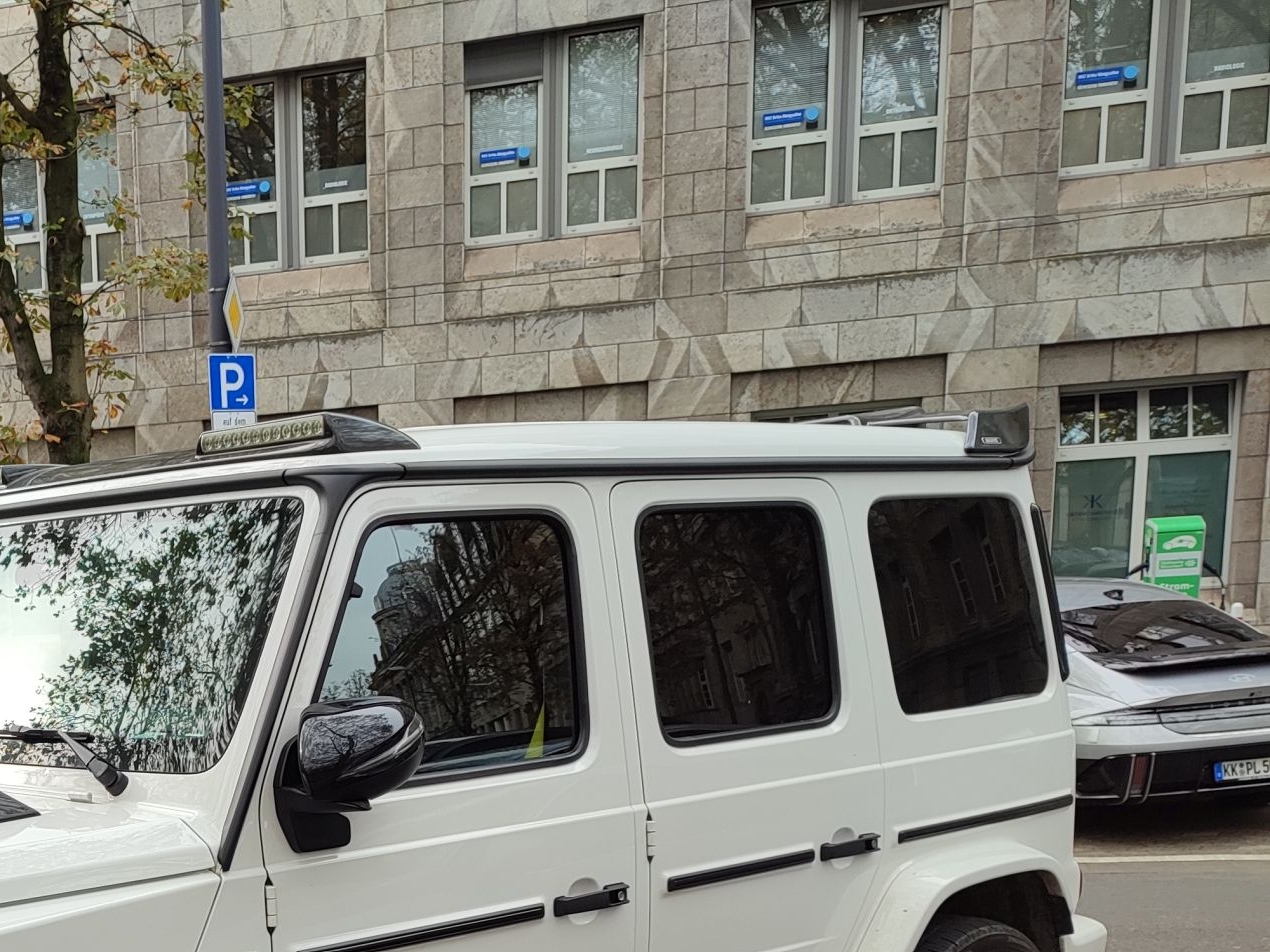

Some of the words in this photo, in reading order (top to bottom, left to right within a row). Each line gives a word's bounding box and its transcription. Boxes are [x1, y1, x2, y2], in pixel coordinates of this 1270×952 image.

[219, 362, 245, 409] P
[222, 418, 232, 427] auf
[234, 416, 247, 426] dem
[1223, 762, 1238, 777] KK
[1246, 761, 1261, 775] PL
